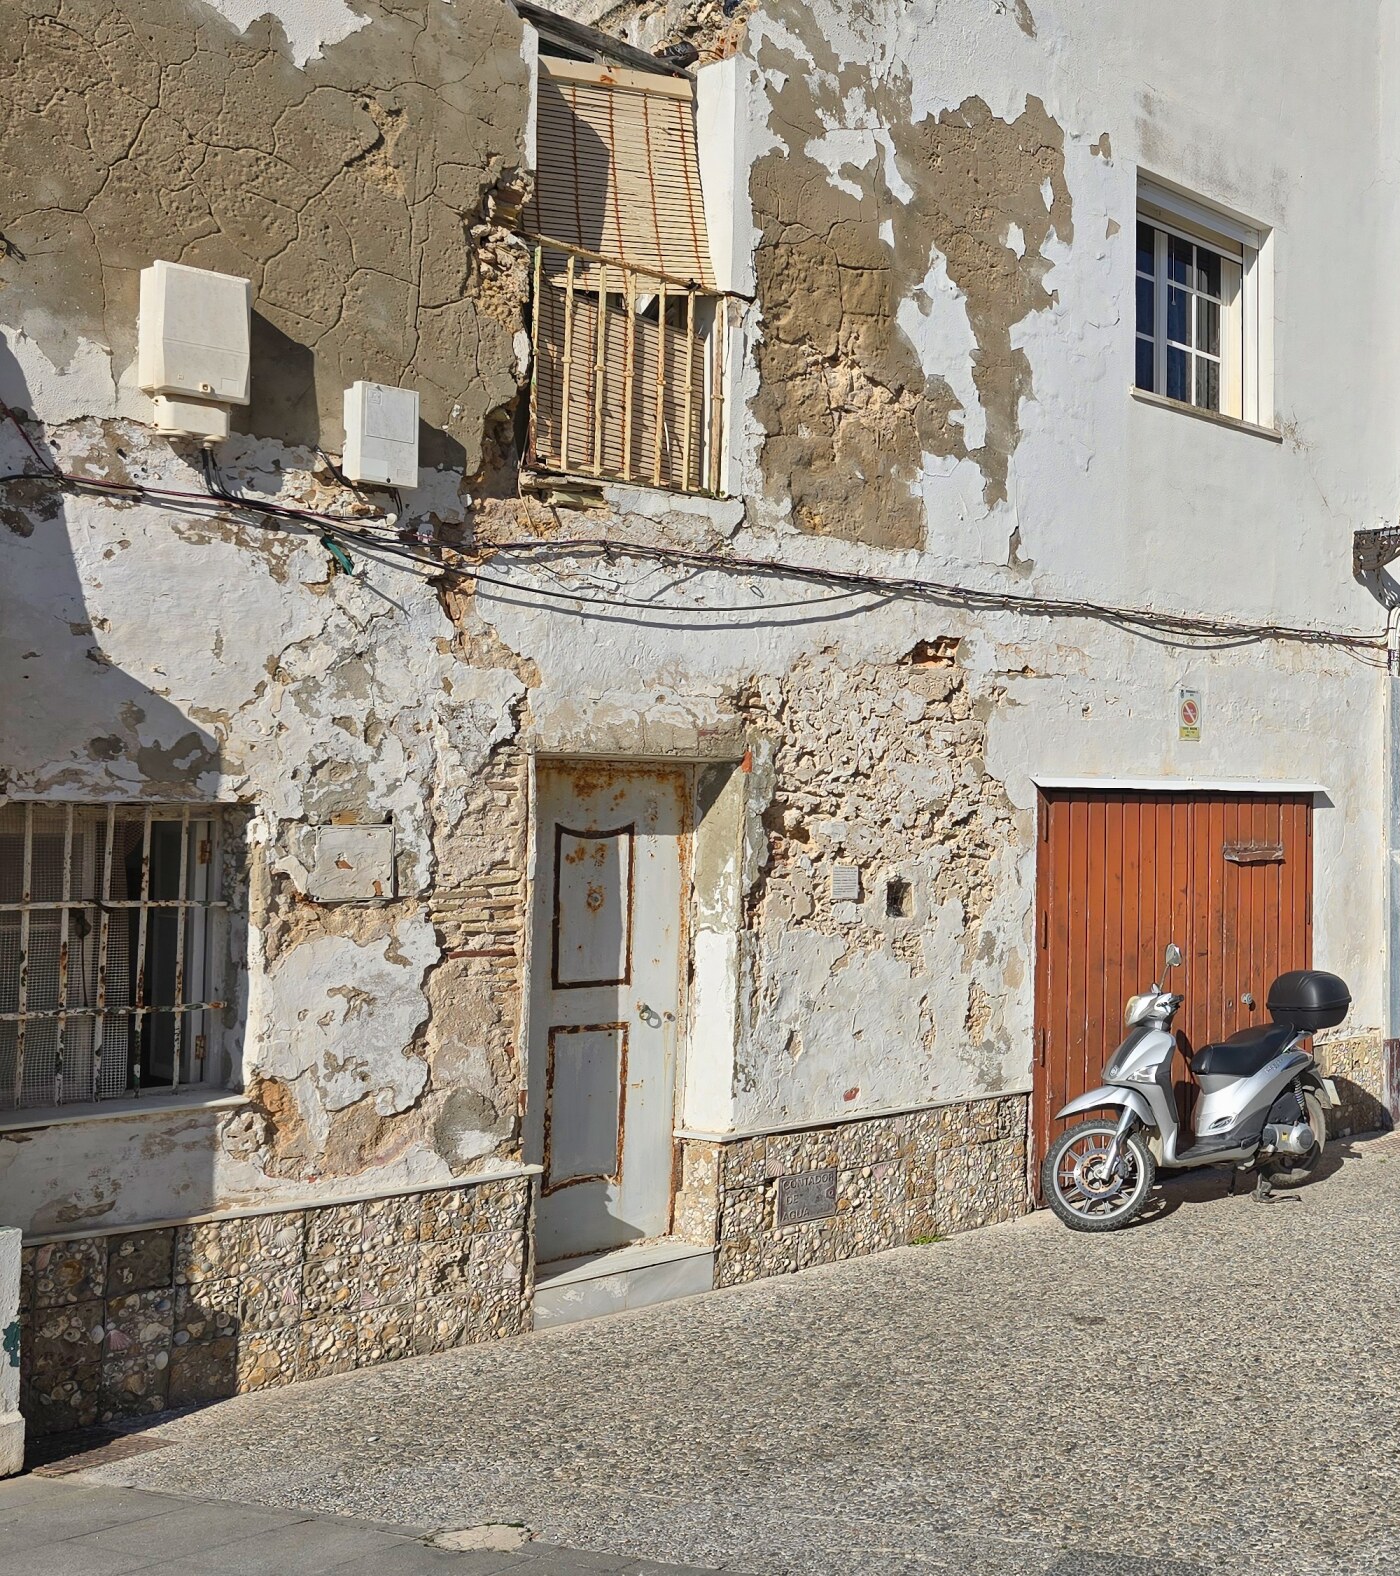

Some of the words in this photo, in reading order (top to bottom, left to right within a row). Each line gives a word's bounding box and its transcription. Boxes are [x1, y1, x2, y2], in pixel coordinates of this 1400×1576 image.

[783, 1173, 834, 1191] CONTADOR
[786, 1194, 799, 1206] DE
[782, 1207, 810, 1222] AGUA
